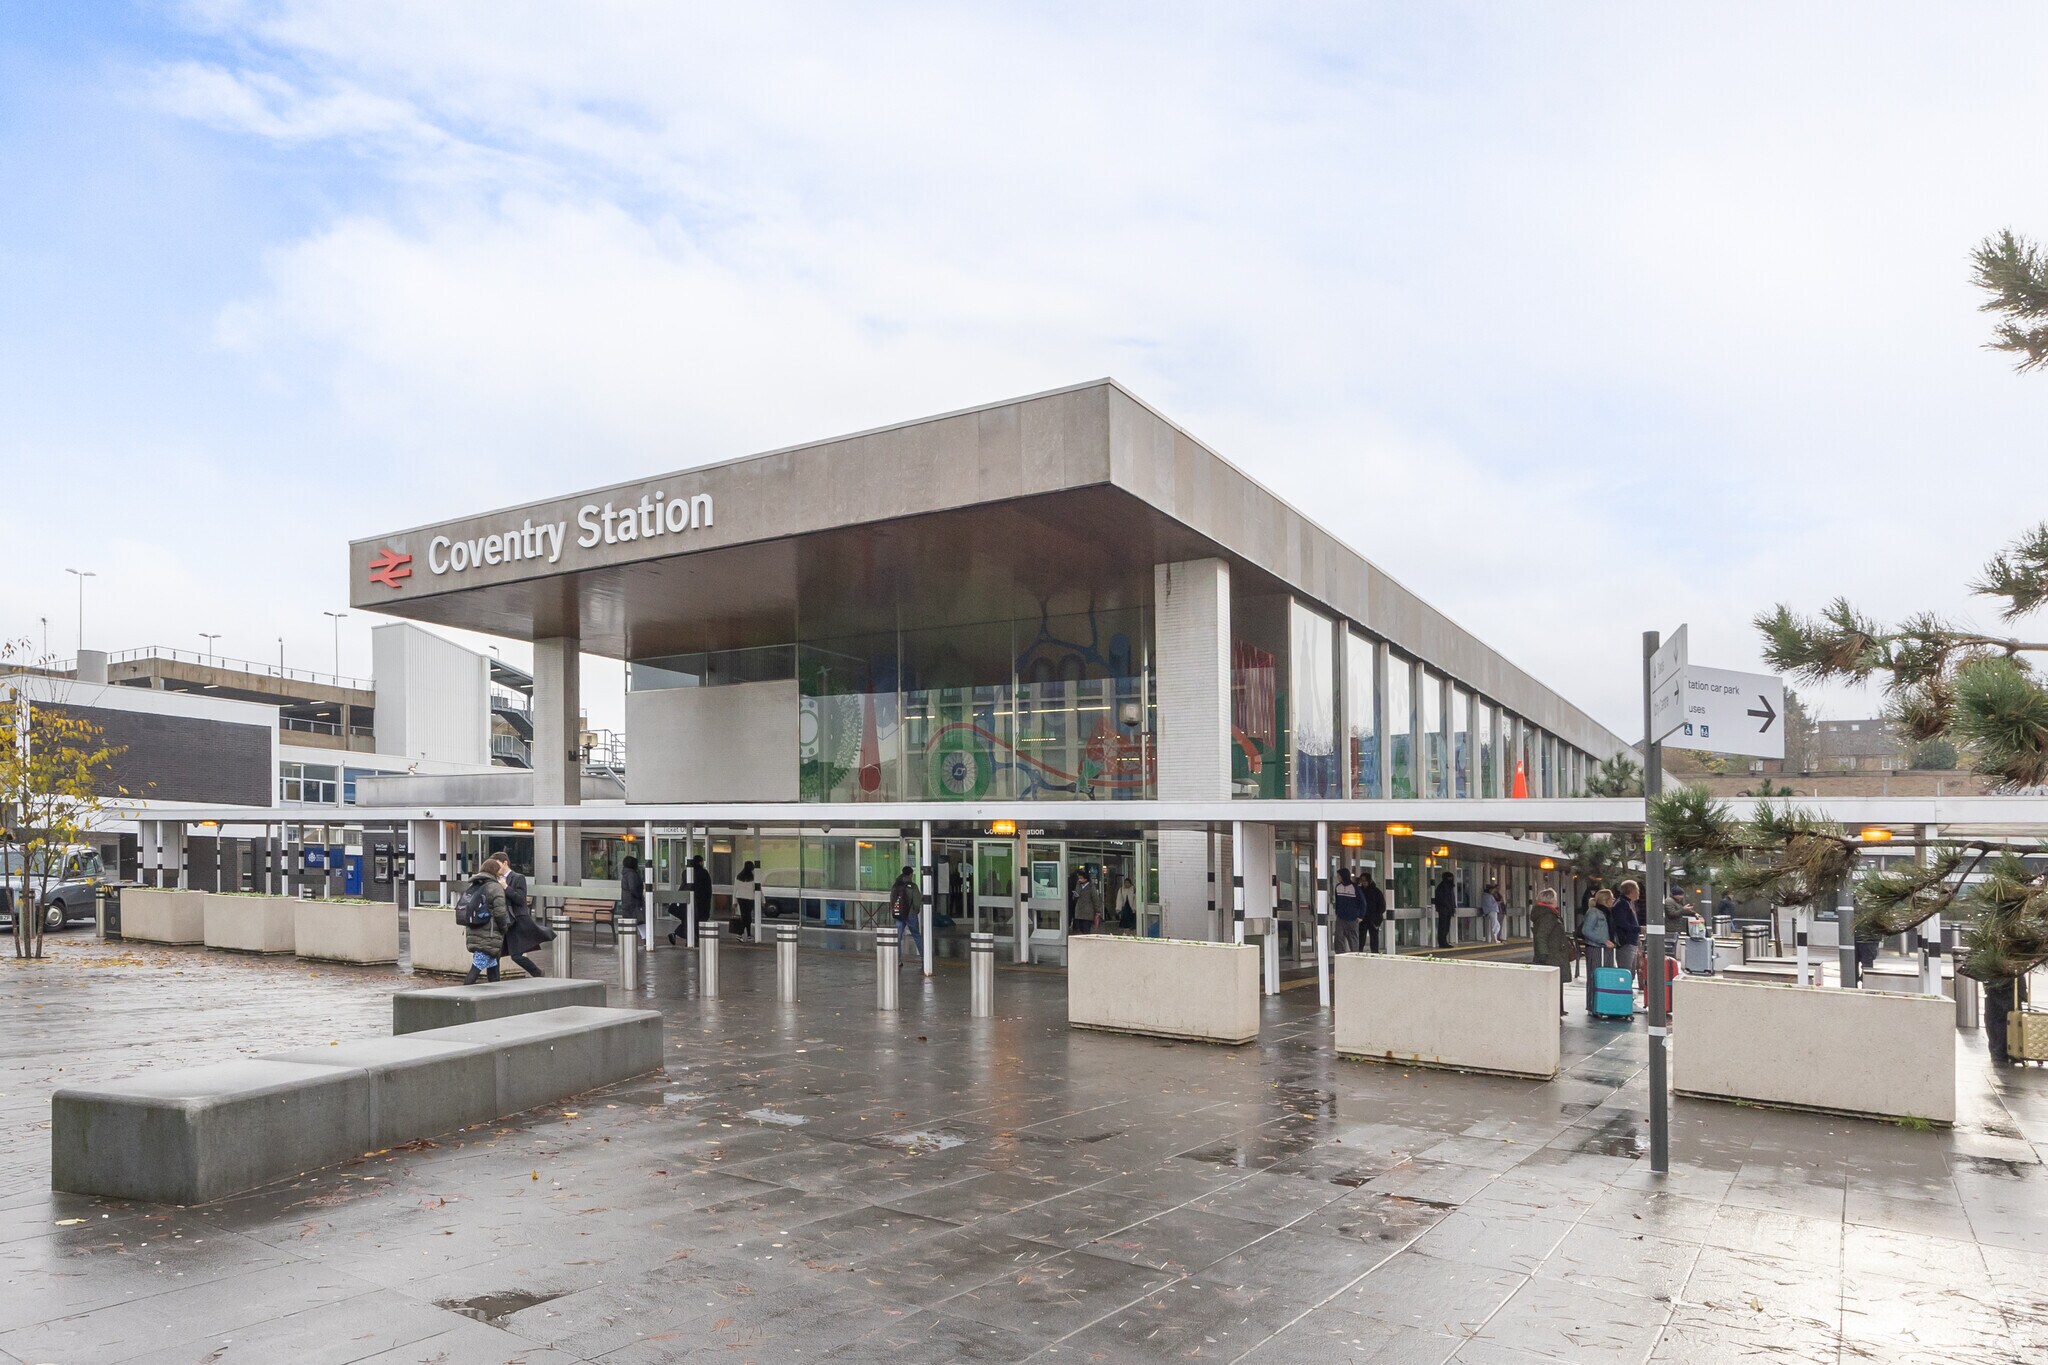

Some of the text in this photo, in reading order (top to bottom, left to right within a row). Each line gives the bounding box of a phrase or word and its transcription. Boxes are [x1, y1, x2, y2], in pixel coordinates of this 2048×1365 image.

[428, 490, 715, 576] Coventry Station
[1688, 680, 1740, 695] tation car park
[1688, 704, 1706, 714] uses
